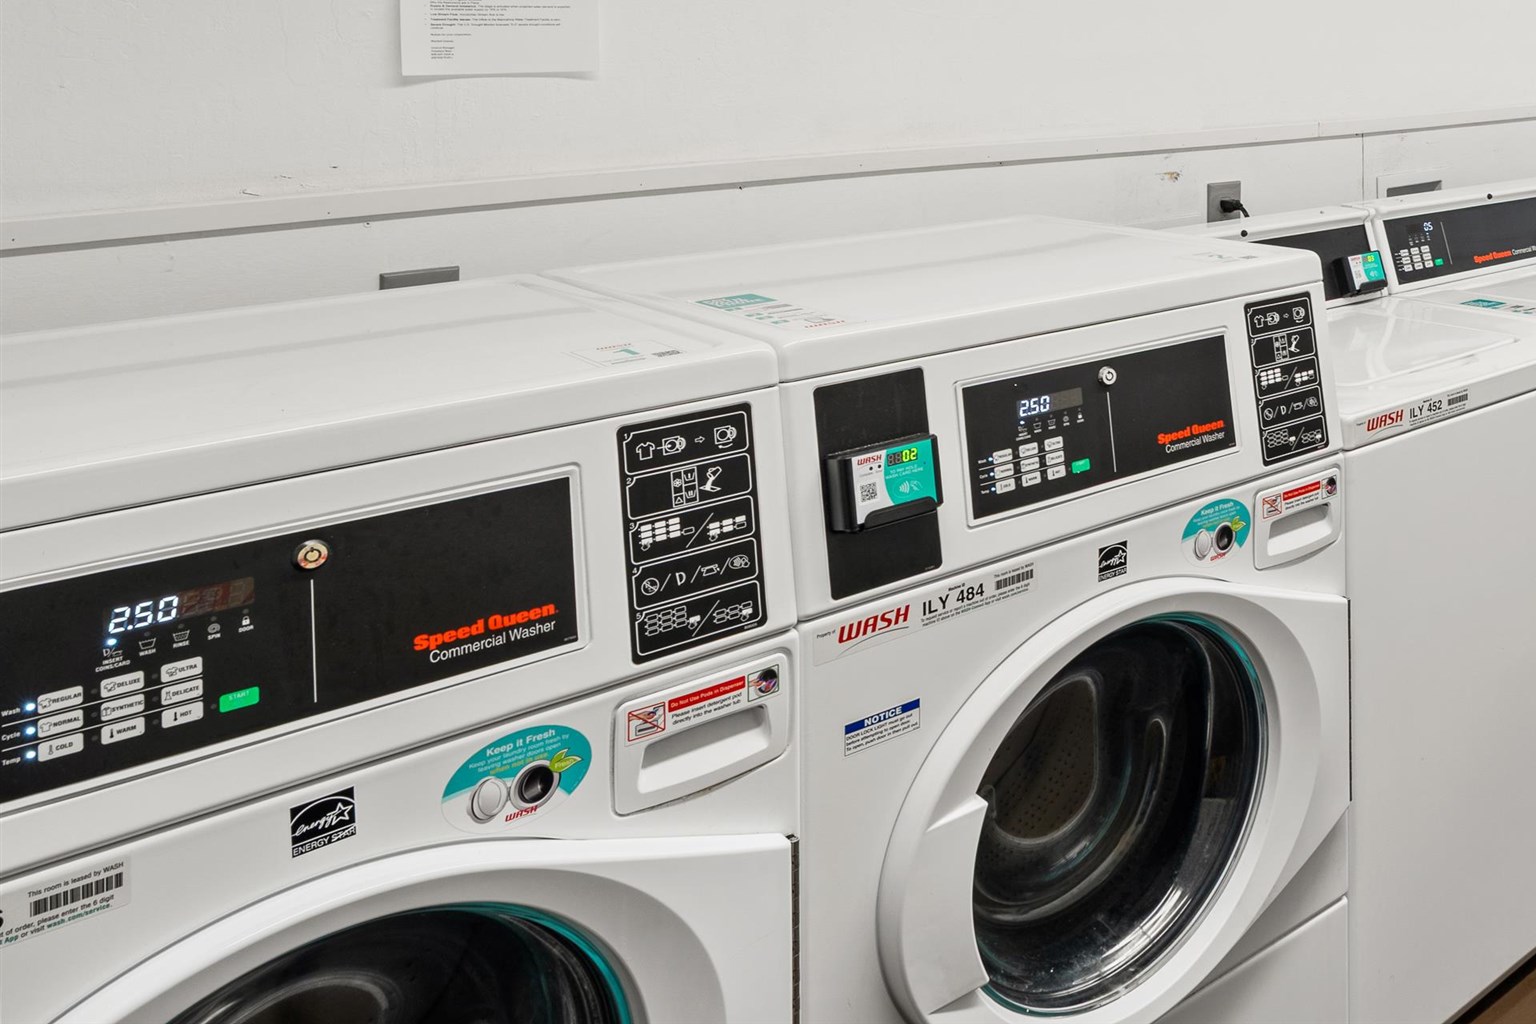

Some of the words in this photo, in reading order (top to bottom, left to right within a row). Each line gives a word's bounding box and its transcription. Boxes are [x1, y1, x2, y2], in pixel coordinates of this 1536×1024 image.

[1020, 395, 1050, 417] 2.50
[1367, 409, 1403, 432] WASH
[1409, 405, 1424, 419] ILY
[1427, 400, 1442, 413] 452
[1158, 426, 1191, 444] Speed
[1192, 420, 1224, 434] Queen
[1166, 436, 1201, 453] Commercial
[1202, 432, 1224, 443] Washer
[857, 454, 882, 465] WASH
[922, 594, 950, 616] ILY
[956, 583, 984, 603] 484
[109, 595, 179, 634] 2.50
[838, 604, 910, 644] WASH
[413, 619, 485, 651] Speed
[488, 603, 556, 630] Queen
[430, 634, 506, 664] Commercial
[509, 620, 556, 641] Washer
[178, 664, 198, 672] ULTRA
[117, 678, 140, 687] DELUXE
[172, 686, 199, 697] DELICATE
[700, 690, 713, 699] Pods
[720, 680, 744, 693] Dispenser
[1, 708, 20, 717] Wash
[51, 692, 82, 704] REGULAR
[112, 700, 144, 712] SYNTHETIC
[179, 709, 192, 718] HOT
[672, 710, 690, 719] Please
[691, 704, 706, 713] insert
[707, 696, 731, 709] detergent
[732, 692, 742, 701] pod
[672, 716, 692, 726] directly
[713, 703, 732, 712] washer
[864, 706, 902, 726] NOTICE
[2, 731, 20, 741] Cycle
[53, 717, 80, 727] NORMAL
[116, 725, 136, 734] WARM
[846, 732, 860, 741] DOOR
[874, 723, 887, 732] LIGHT
[861, 730, 883, 741] attempting
[2, 757, 21, 766] Temp
[56, 742, 73, 750] COLD
[469, 759, 486, 769] Keep
[488, 756, 501, 764] your
[503, 747, 526, 758] laundry
[546, 737, 560, 745] fresh
[486, 743, 513, 756] Keep
[516, 738, 523, 747] it
[526, 729, 555, 744] Fresh
[478, 761, 501, 772] leaving
[502, 755, 525, 764] washer
[527, 748, 544, 758] doors
[546, 743, 561, 751] open
[505, 805, 538, 822] WASH
[293, 837, 330, 856] ENERGY
[331, 825, 355, 842] STAR
[28, 889, 42, 897] This
[44, 883, 61, 892] room
[71, 873, 91, 883] leased
[103, 862, 124, 873] WASH
[4, 935, 18, 944] App
[30, 926, 45, 934] visit
[47, 903, 112, 929] wash.com/service.
[15, 922, 35, 932] order,
[37, 914, 59, 926] please
[61, 908, 78, 917] enter
[99, 894, 114, 903] digit
